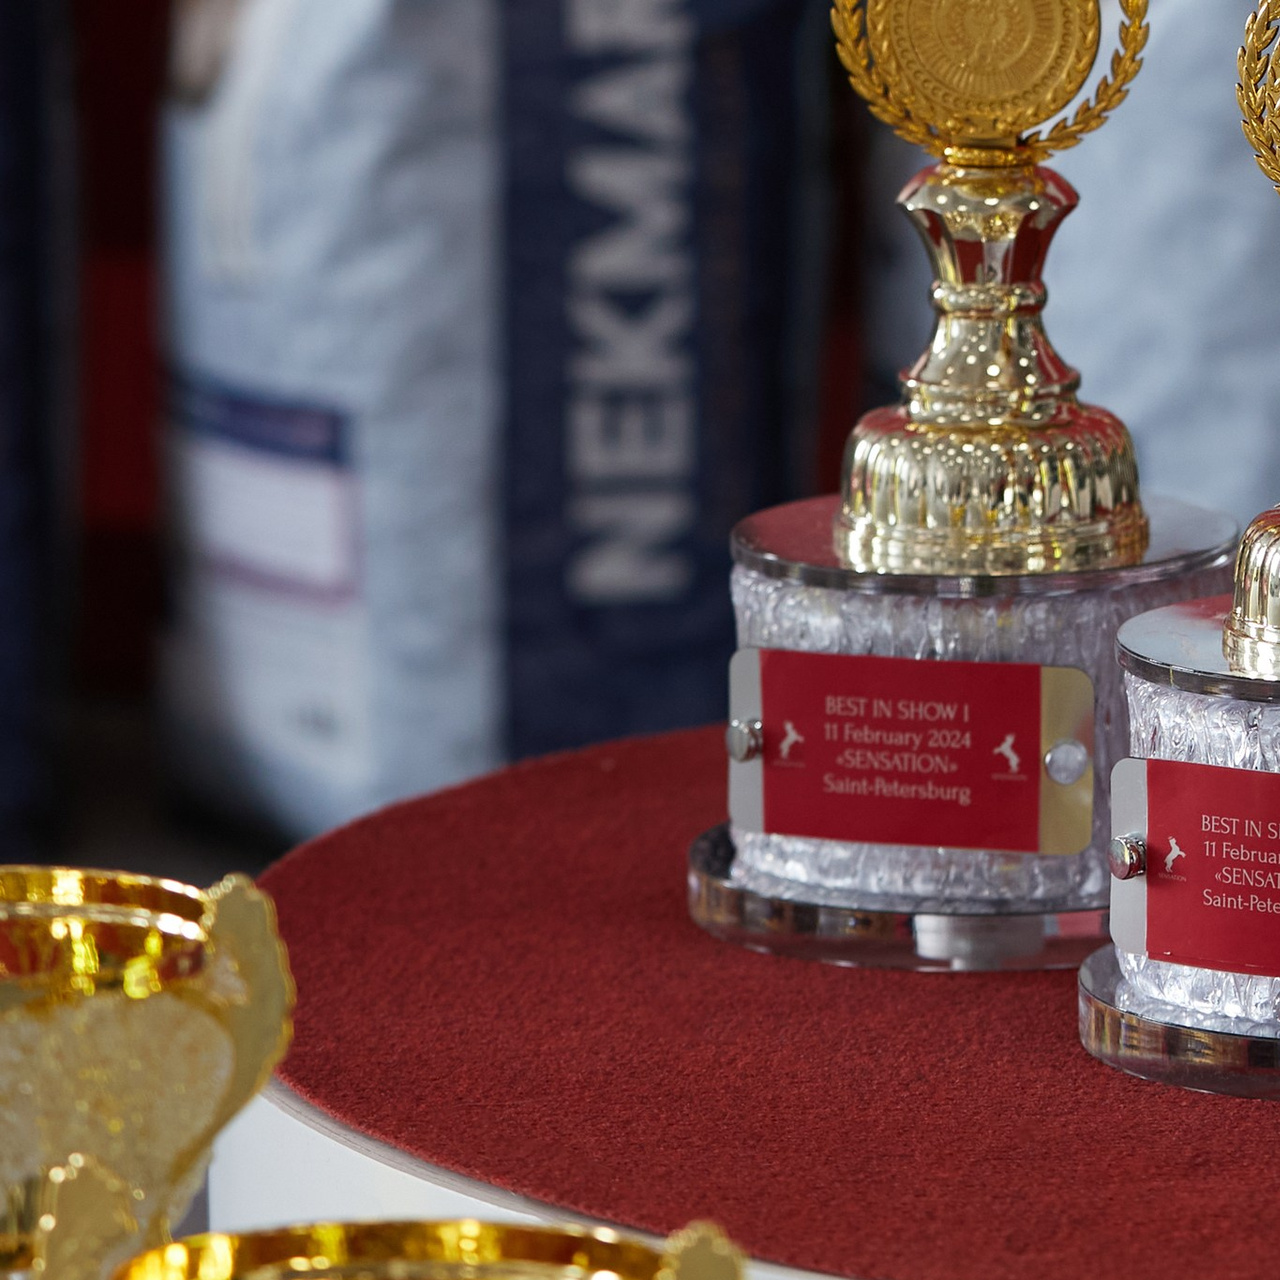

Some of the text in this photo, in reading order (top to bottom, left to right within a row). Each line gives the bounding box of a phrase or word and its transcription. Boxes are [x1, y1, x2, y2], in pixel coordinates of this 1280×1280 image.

[826, 696, 969, 722] BEST IN SHOW I
[824, 722, 971, 751] 11 February 2024
[836, 749, 957, 773] «SENSATION»
[823, 773, 971, 806] Saint-Petersburg
[1202, 815, 1239, 834] BEST
[1245, 820, 1261, 837] IN
[1204, 841, 1215, 857] 11
